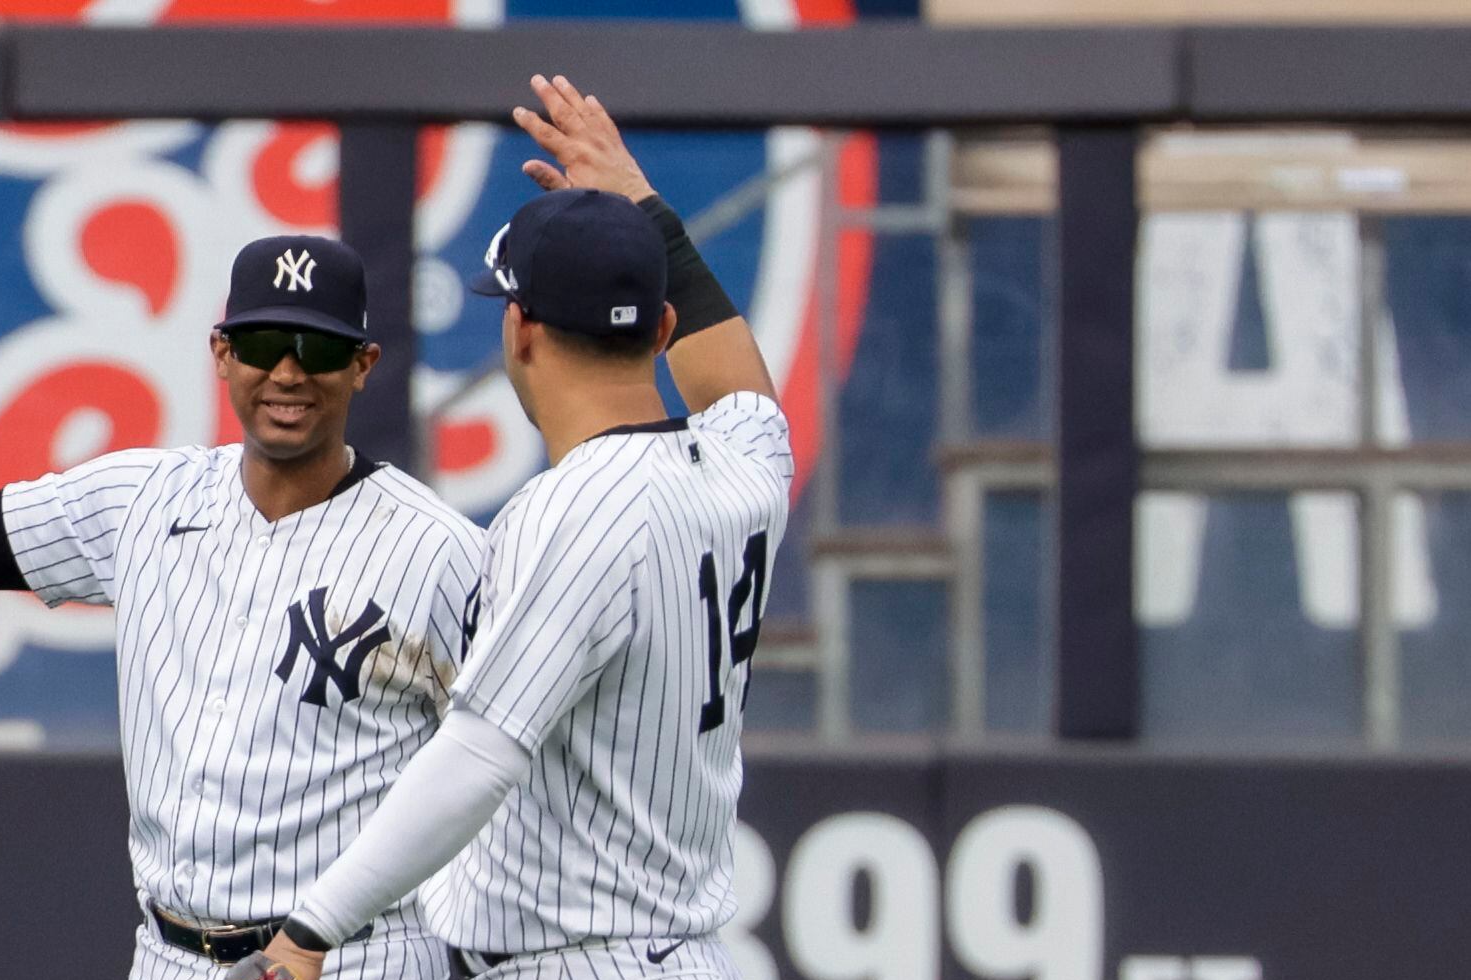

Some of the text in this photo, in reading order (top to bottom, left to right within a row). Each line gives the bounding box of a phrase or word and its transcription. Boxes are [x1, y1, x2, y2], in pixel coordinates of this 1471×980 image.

[273, 248, 317, 292] NY
[275, 586, 392, 708] NY
[698, 530, 768, 734] 14
